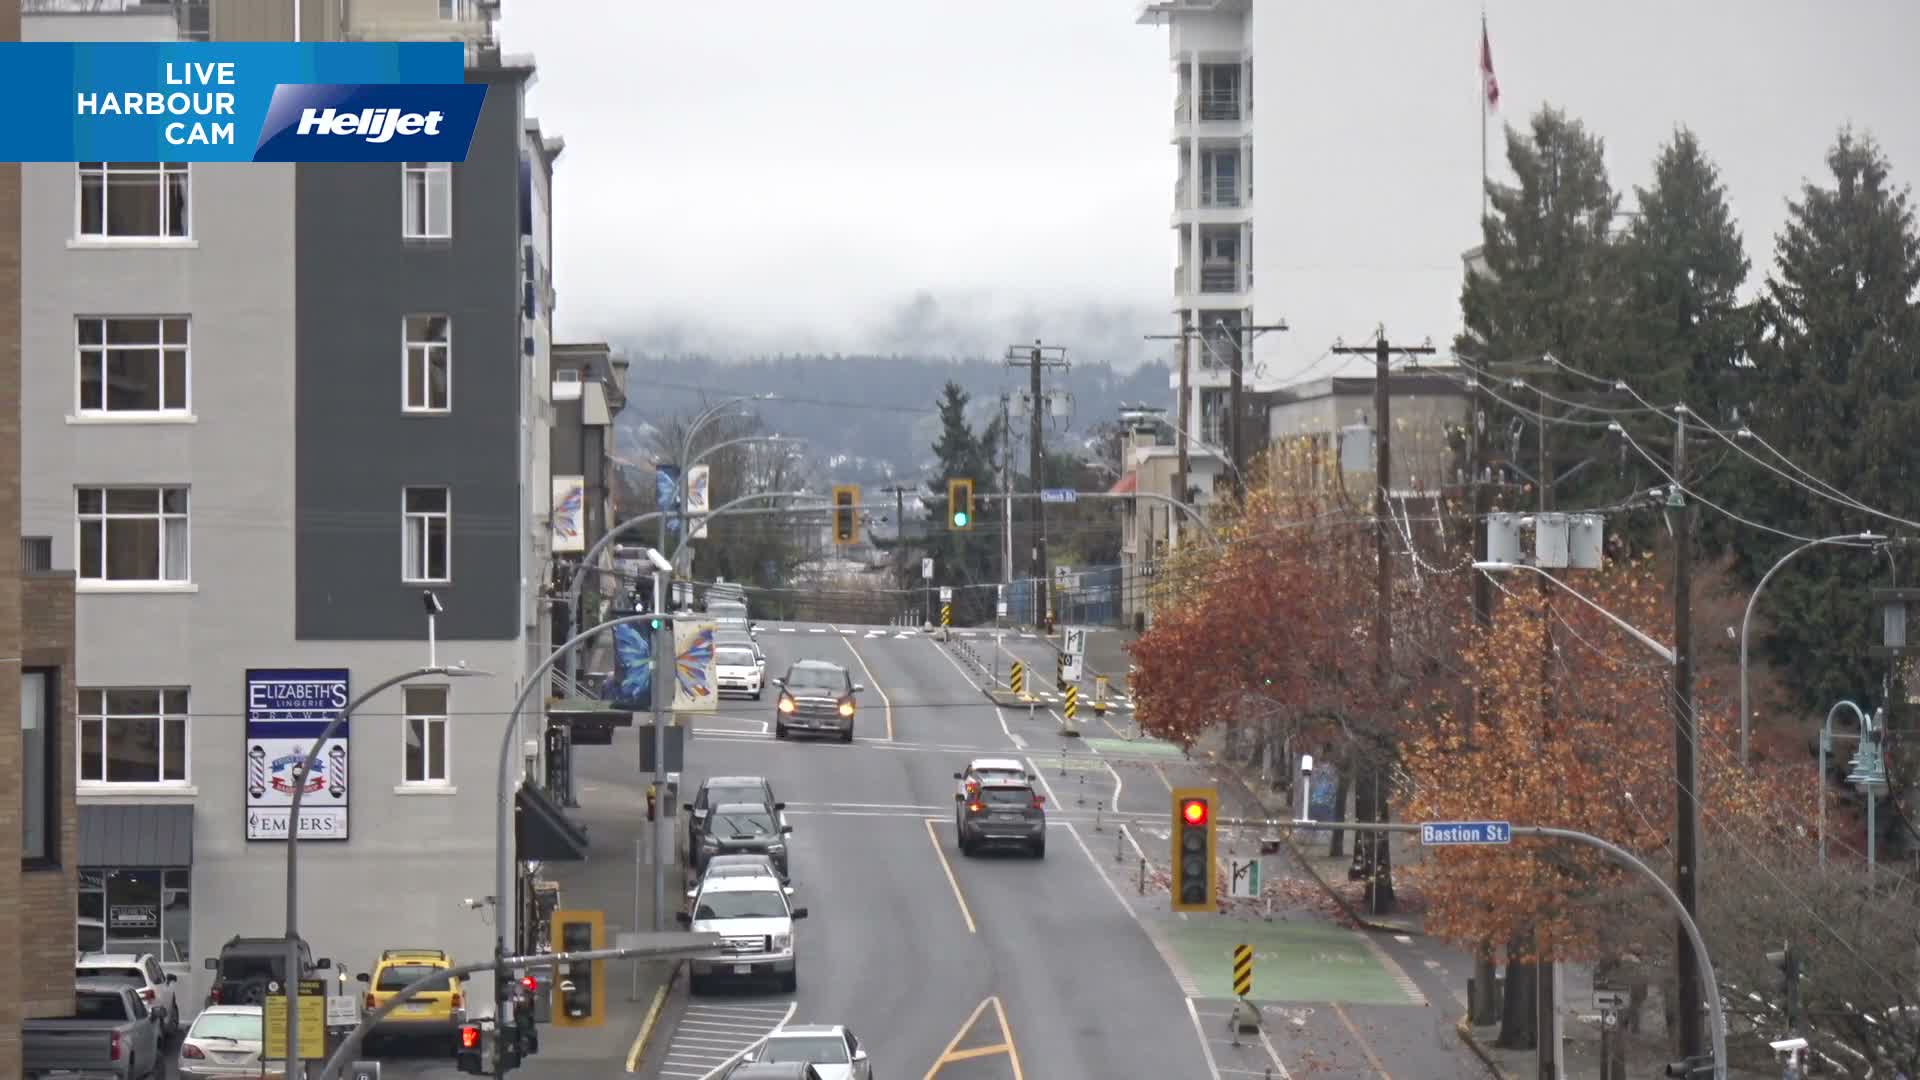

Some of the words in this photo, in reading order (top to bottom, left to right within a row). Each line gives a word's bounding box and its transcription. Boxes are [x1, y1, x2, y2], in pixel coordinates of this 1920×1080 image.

[250, 683, 347, 708] ELIZABETH'S
[276, 700, 324, 708] LINGERIE
[261, 817, 333, 831] EMERS
[1423, 825, 1480, 842] Bastion
[1486, 824, 1508, 842] St.
